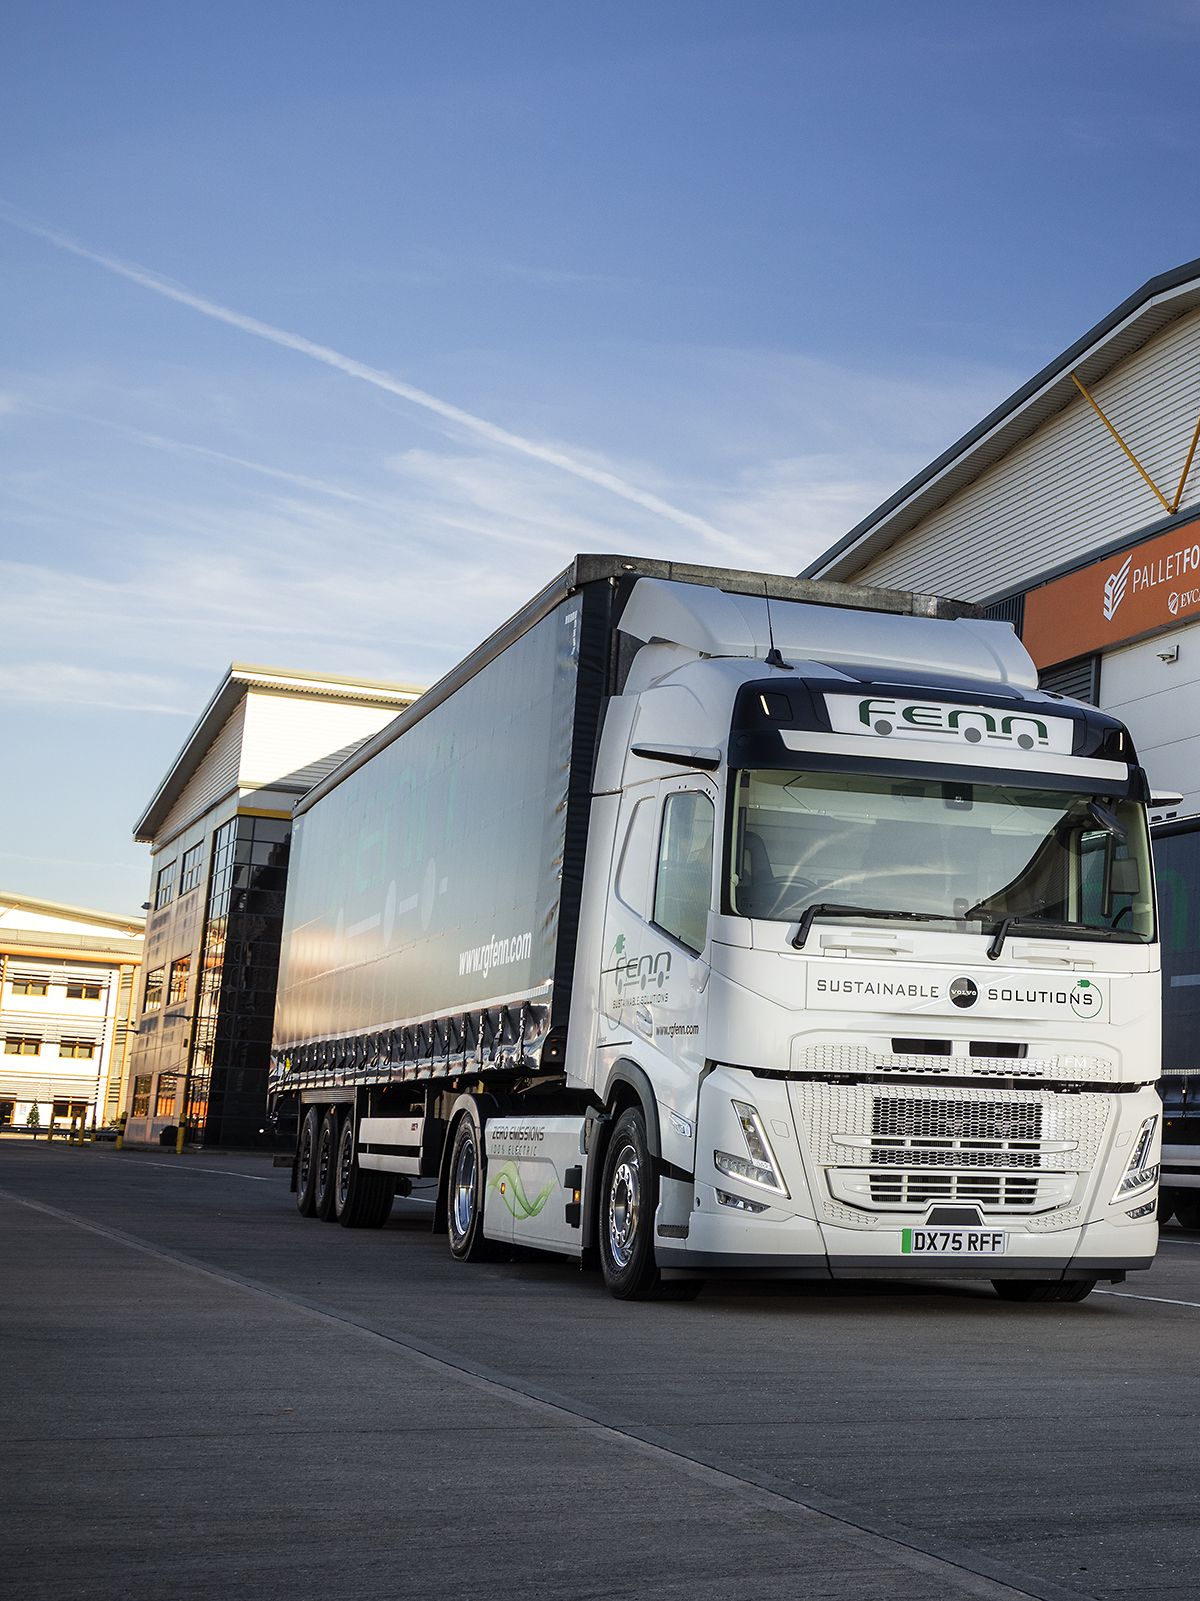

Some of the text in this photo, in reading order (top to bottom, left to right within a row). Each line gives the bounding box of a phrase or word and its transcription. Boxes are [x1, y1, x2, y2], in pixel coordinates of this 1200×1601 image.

[459, 932, 532, 979] www.rgfenn.com
[816, 979, 1093, 1005] SUSTAINABLE VOLVO SOLUTIONS
[655, 1023, 700, 1039] www.rgfenn.com
[492, 1126, 545, 1141] ZERO EMISSIONS
[914, 1232, 1003, 1252] DX75 RFF
